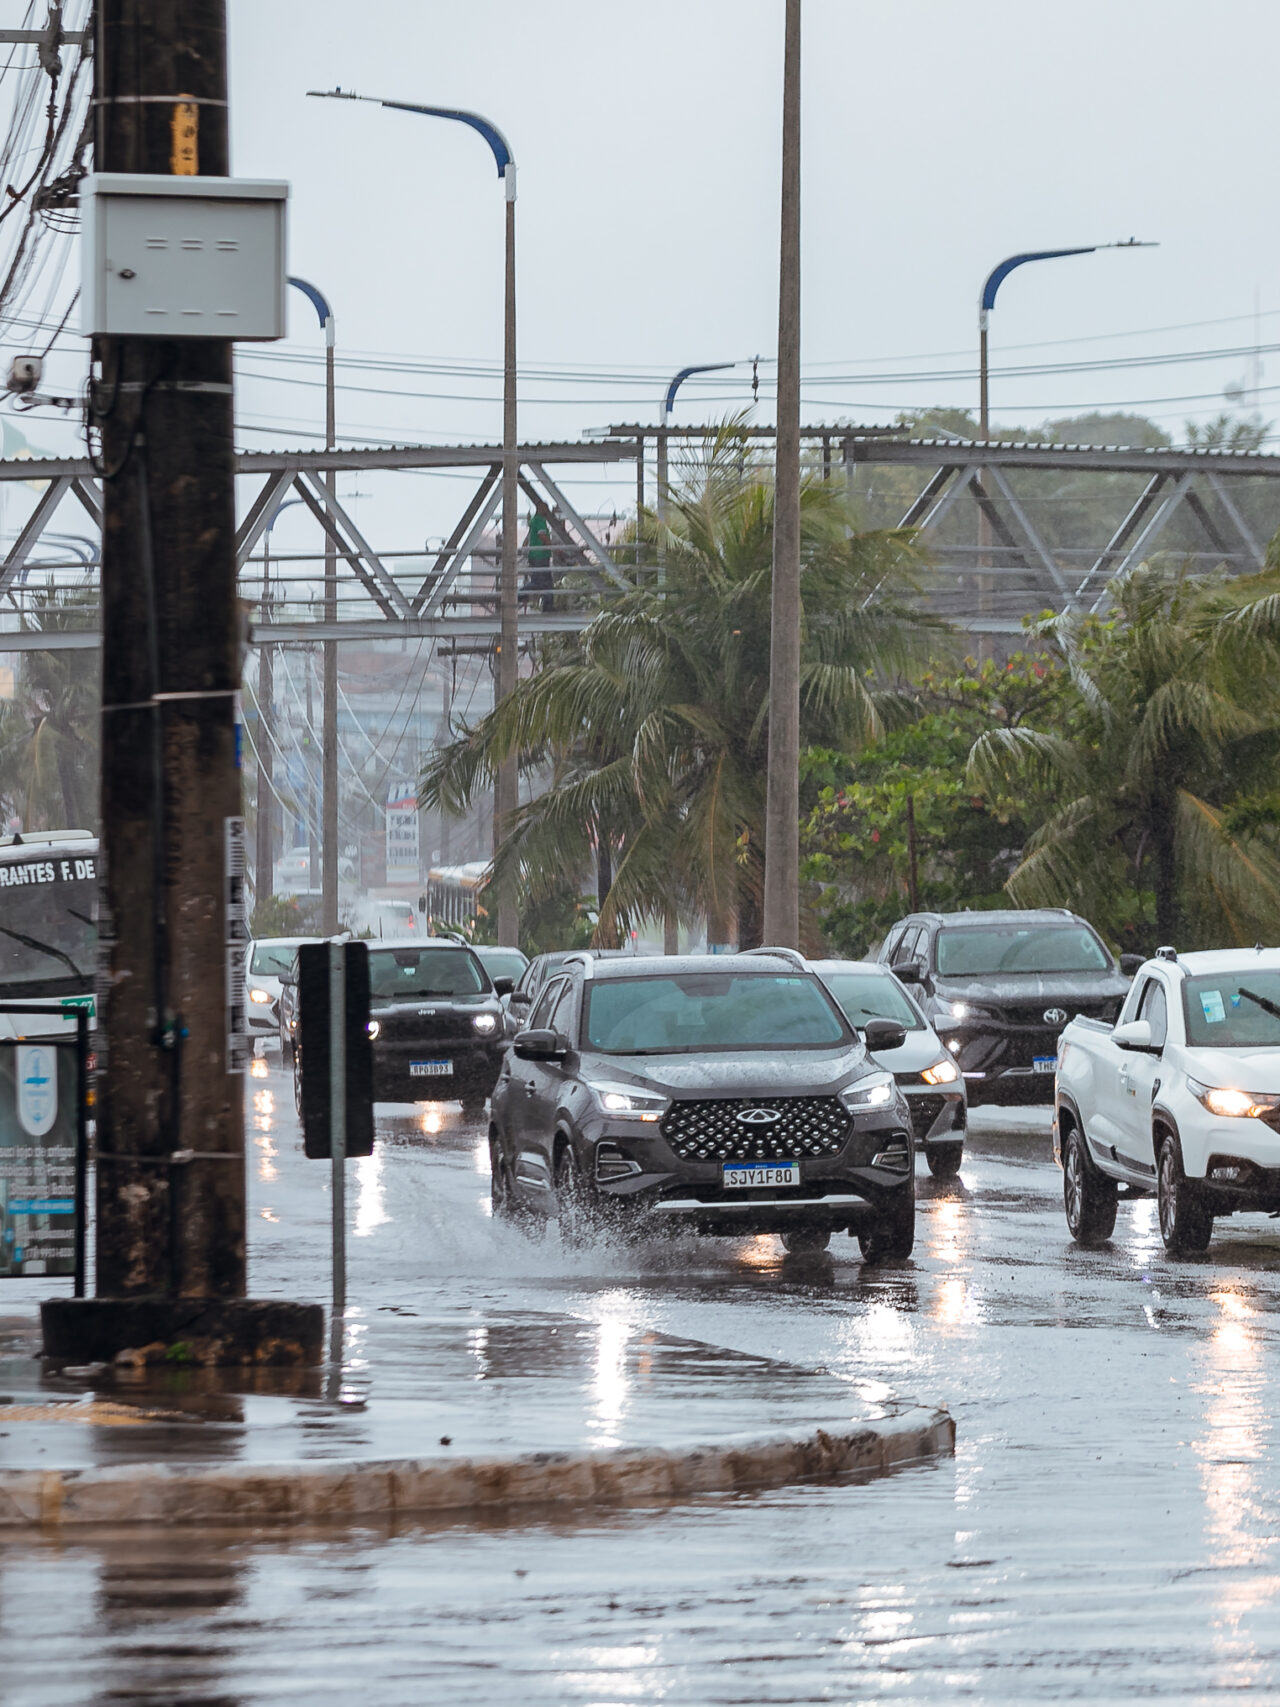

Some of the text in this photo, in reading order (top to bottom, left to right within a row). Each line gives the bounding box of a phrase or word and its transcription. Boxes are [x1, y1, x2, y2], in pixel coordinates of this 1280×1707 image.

[61, 861, 74, 881] F.
[75, 860, 96, 880] DE
[730, 1169, 793, 1185] SJY1F80
